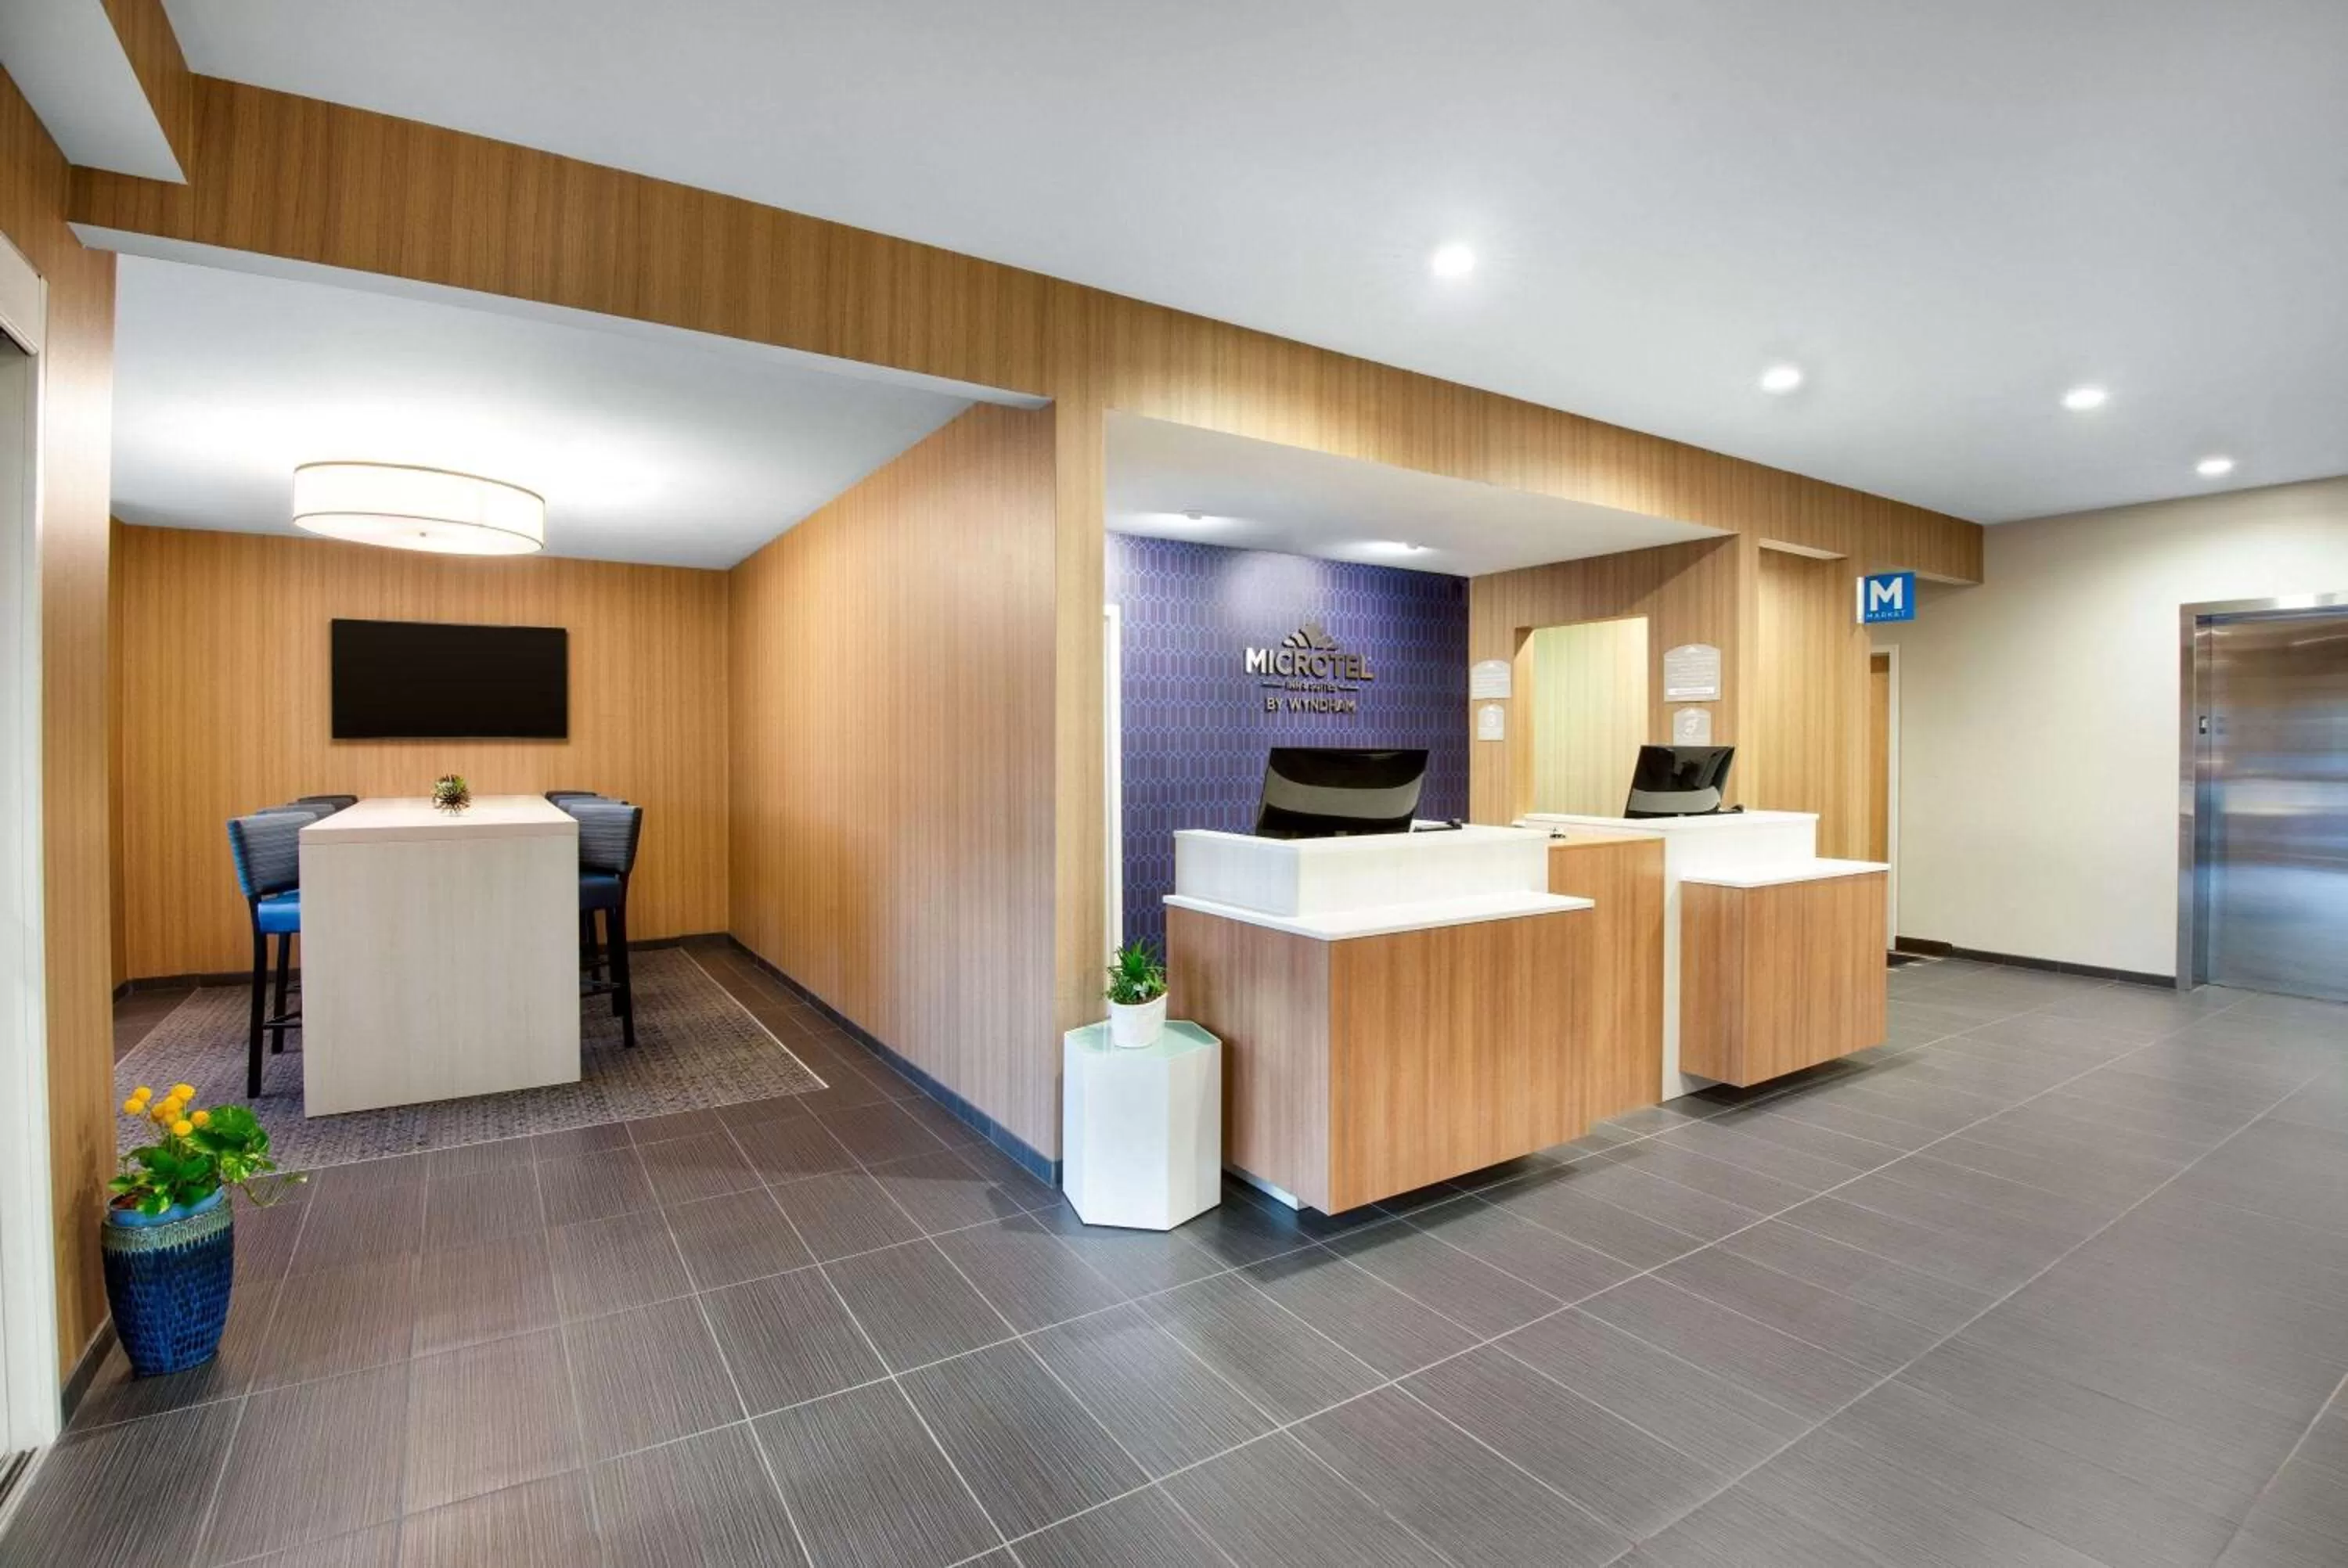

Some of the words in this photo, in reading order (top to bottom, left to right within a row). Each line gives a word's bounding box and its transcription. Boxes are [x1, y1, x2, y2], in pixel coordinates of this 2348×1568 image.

[1869, 577, 1903, 612] M
[1866, 610, 1906, 620] MARKET
[1244, 647, 1374, 680] MICROTEL
[1266, 696, 1283, 711] BY
[1288, 698, 1356, 714] WYNDHAM
